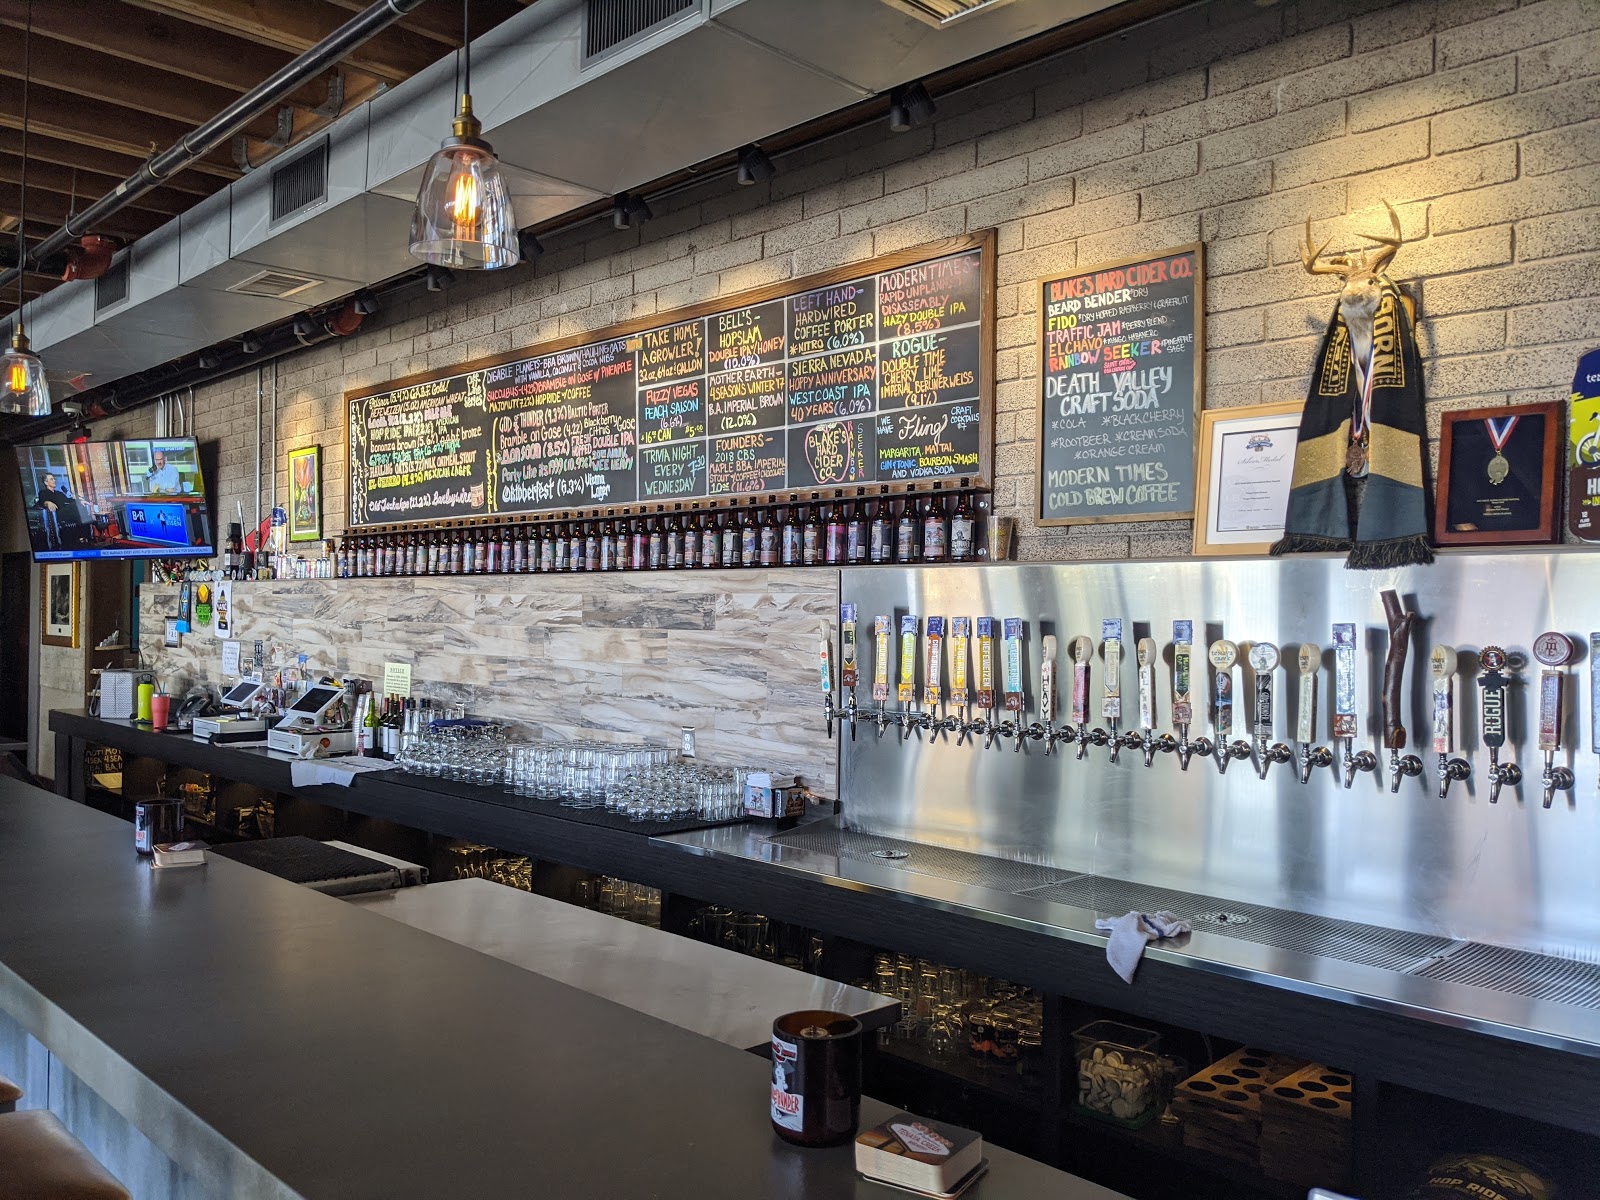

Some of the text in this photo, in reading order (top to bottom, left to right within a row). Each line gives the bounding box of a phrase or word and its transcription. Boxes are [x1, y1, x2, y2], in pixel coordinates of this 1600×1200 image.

[880, 267, 927, 291] MODERN
[1050, 256, 1193, 303] BLAKE'S HARD CIDER CO.
[793, 295, 824, 312] LEFT
[879, 289, 905, 304] RAPID
[881, 294, 949, 316] DISASSEMBLY
[1048, 289, 1131, 318] BEARD BENDER
[795, 301, 857, 326] HARDWIRED
[883, 301, 966, 327] HAZY DOUBLE IPA
[1048, 314, 1077, 332] FIDO
[645, 322, 699, 347] TAKE HOME
[794, 313, 874, 340] COFFEE PORTER
[897, 318, 940, 337] (8.5%)
[1047, 320, 1121, 345] TRAFFIC JAM
[720, 325, 763, 348] HOPSLAM
[826, 331, 864, 350] (6.0%)
[600, 351, 615, 364] NIBS
[709, 344, 751, 363] DOUBLE IPA
[1049, 349, 1100, 372] RAINBOW
[1103, 339, 1162, 361] SEEKER
[1167, 345, 1186, 353] SAGE
[601, 360, 633, 379] PINEAPPLE
[676, 358, 703, 375] GALLON
[724, 353, 760, 369] (10.0%)
[792, 359, 827, 377] SIERRA
[881, 348, 946, 374] DOUBLE TIME
[710, 369, 742, 386] MOTHER
[789, 366, 876, 391] HOPPY ANNIVERSARY
[884, 363, 943, 385] CHERRY LIME
[1046, 373, 1100, 398] DEATH
[1111, 366, 1173, 394] VALLEY
[646, 382, 699, 404] FUZZY VEGAS
[748, 378, 773, 395] WINTER
[789, 384, 870, 404] WEST COAST IPA
[881, 379, 913, 398] IMPERIAL
[645, 398, 699, 420] PEACH SAISON
[723, 392, 784, 414] IMPERIAL BROWN
[905, 391, 937, 408] (9.1%)
[1060, 387, 1161, 417] CRAFT SODA
[520, 406, 587, 426] THUNDER BALTIC
[790, 397, 872, 422] 40 YEARS (6.0%)
[950, 413, 979, 424] COCKTAILS
[951, 406, 973, 416] CRAFT
[1142, 408, 1186, 425] CHERRY
[660, 414, 683, 430] (6.6%)
[721, 413, 757, 431] (12.0%)
[877, 425, 894, 435] HAVE
[880, 416, 891, 425] WE
[898, 414, 948, 445] Fling
[500, 425, 562, 450] Bramble Gose
[592, 429, 634, 448] DOUBLE IPA
[658, 428, 672, 441] CAN
[808, 428, 847, 449] BLAKE'S
[1157, 426, 1188, 438] SODA
[672, 444, 698, 460] NIGHT
[716, 450, 755, 462] 2018 CBS
[816, 443, 838, 456] HARD
[1128, 442, 1166, 456] CREAM
[654, 463, 684, 476] EVERY
[710, 461, 753, 474] MAPLE BBA
[814, 454, 843, 469] CIDER
[919, 455, 953, 467] BOURBON
[502, 467, 522, 483] Party
[710, 473, 729, 483] STOUT
[819, 466, 835, 479] CO.
[892, 464, 955, 478] AND VODKA SODA
[1048, 461, 1168, 488] MODERN TIMES
[557, 476, 584, 497] (6.3%)
[645, 477, 696, 495] WEDNESDAY
[731, 480, 765, 492] (11.6%)
[1049, 482, 1181, 511] COLD BREW COFFEE
[982, 641, 990, 687] HEFEWEIZEN
[1484, 689, 1501, 736] ROGUE
[898, 1128, 921, 1143] TENAYA
[921, 1139, 942, 1153] CREEK
[1429, 1176, 1463, 1187] HOP
